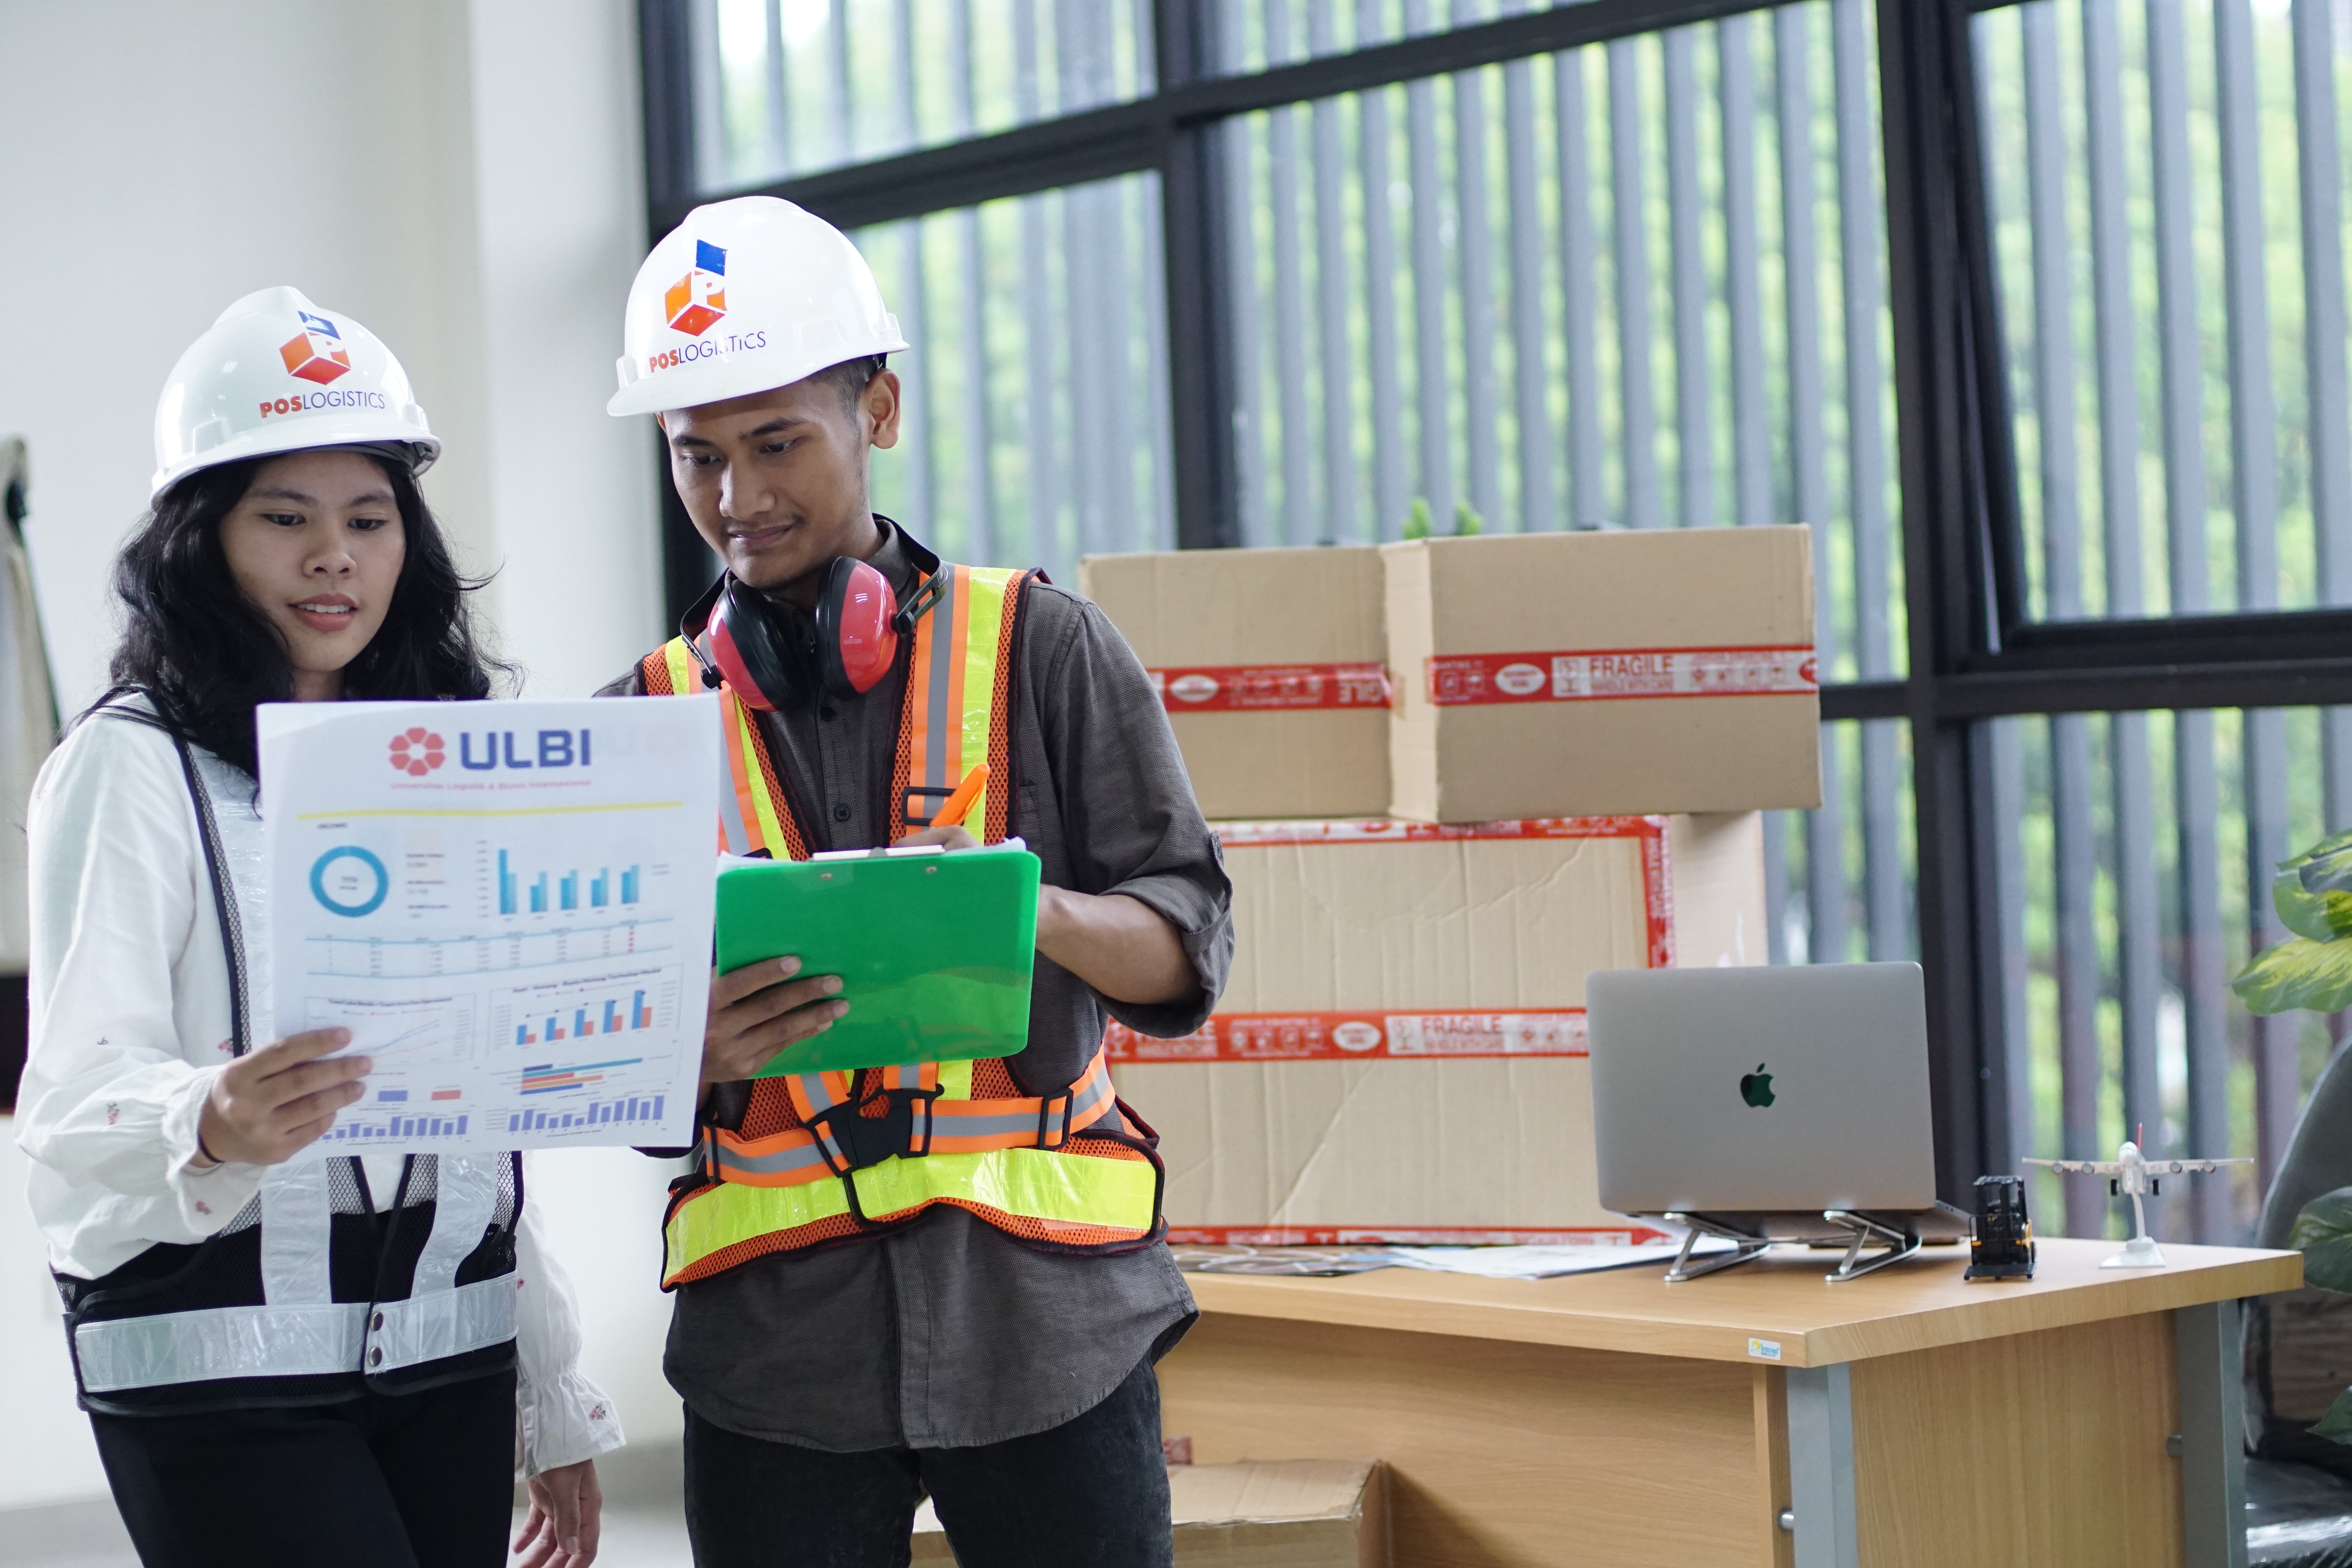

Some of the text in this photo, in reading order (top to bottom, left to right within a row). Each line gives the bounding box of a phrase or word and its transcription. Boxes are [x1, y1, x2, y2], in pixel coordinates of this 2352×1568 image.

[649, 331, 766, 373] POSLOGISTICS
[259, 391, 385, 419] POSLOGISTICS
[1590, 655, 1673, 677] FRAGILE
[1339, 682, 1383, 704] GILE
[459, 729, 592, 771] ULBI
[1422, 1016, 1503, 1035] FRAGILE
